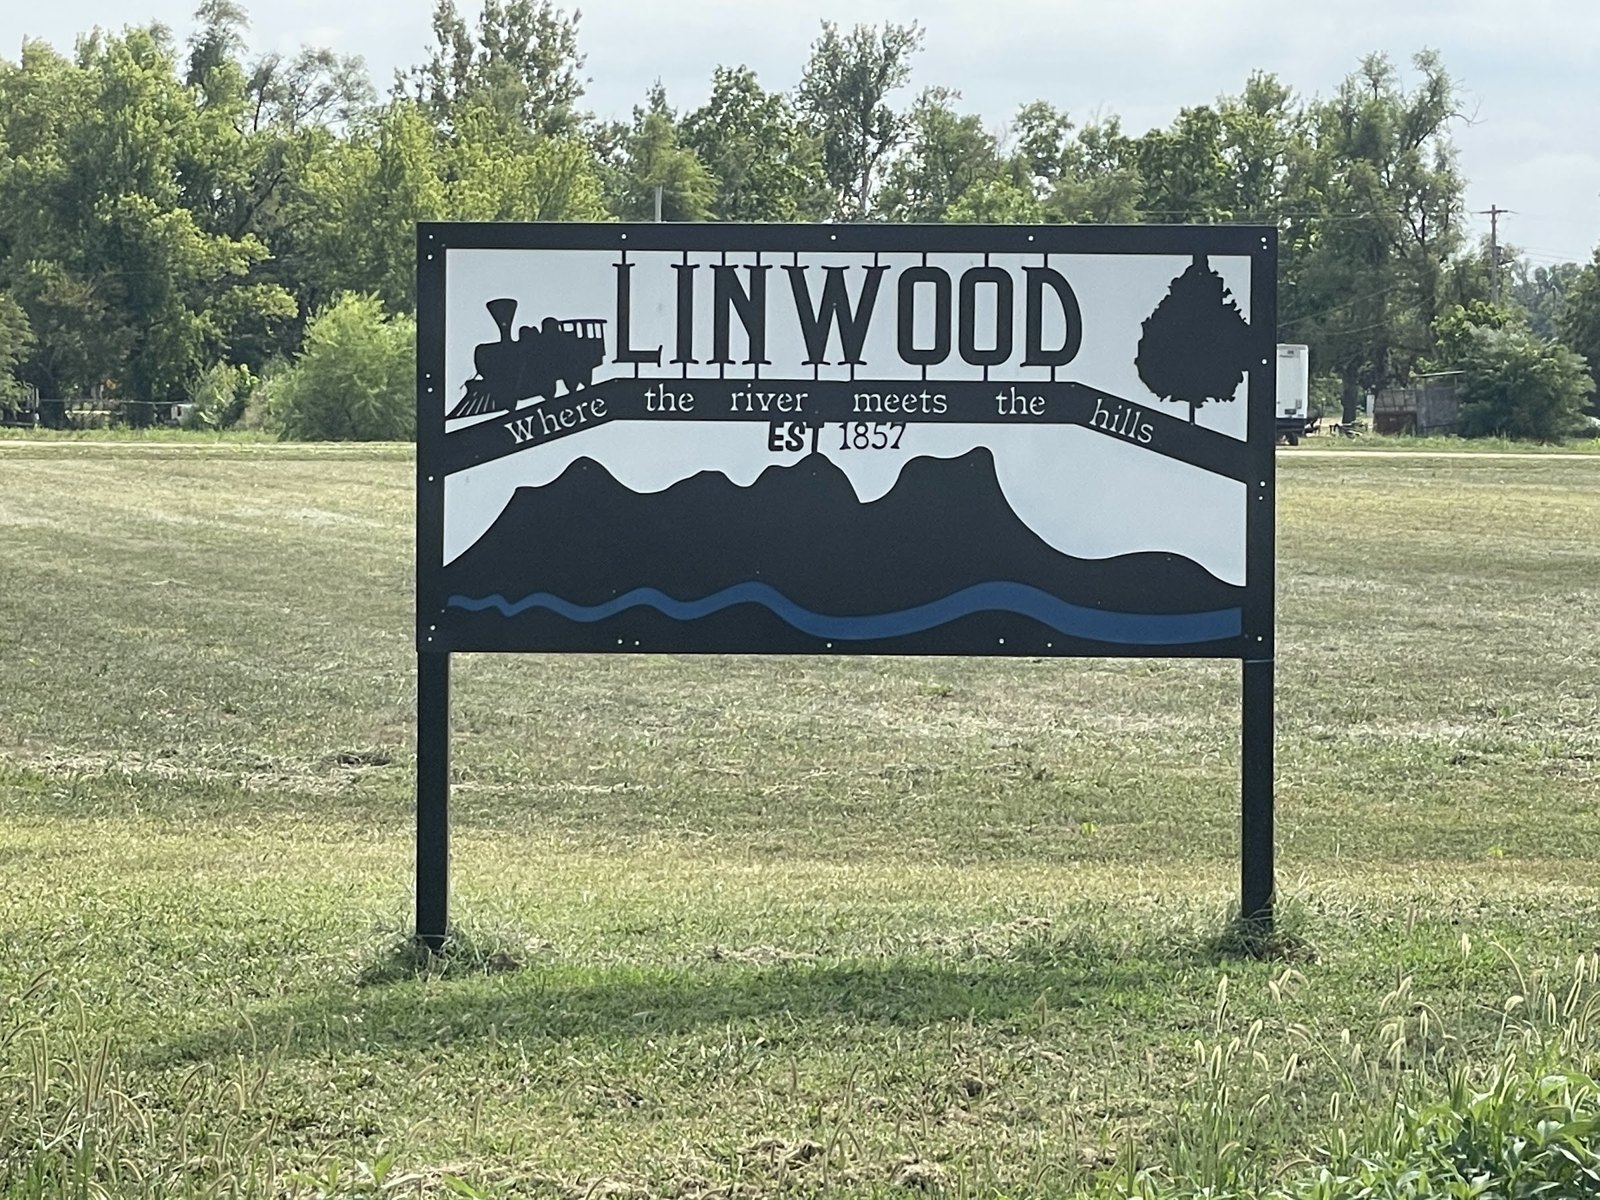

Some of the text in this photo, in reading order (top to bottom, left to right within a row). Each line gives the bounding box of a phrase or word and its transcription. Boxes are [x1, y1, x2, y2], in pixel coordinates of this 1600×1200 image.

[612, 263, 1082, 367] LINWOOD
[505, 383, 1154, 444] Where the river meets the hills
[768, 421, 907, 452] EST 1857
